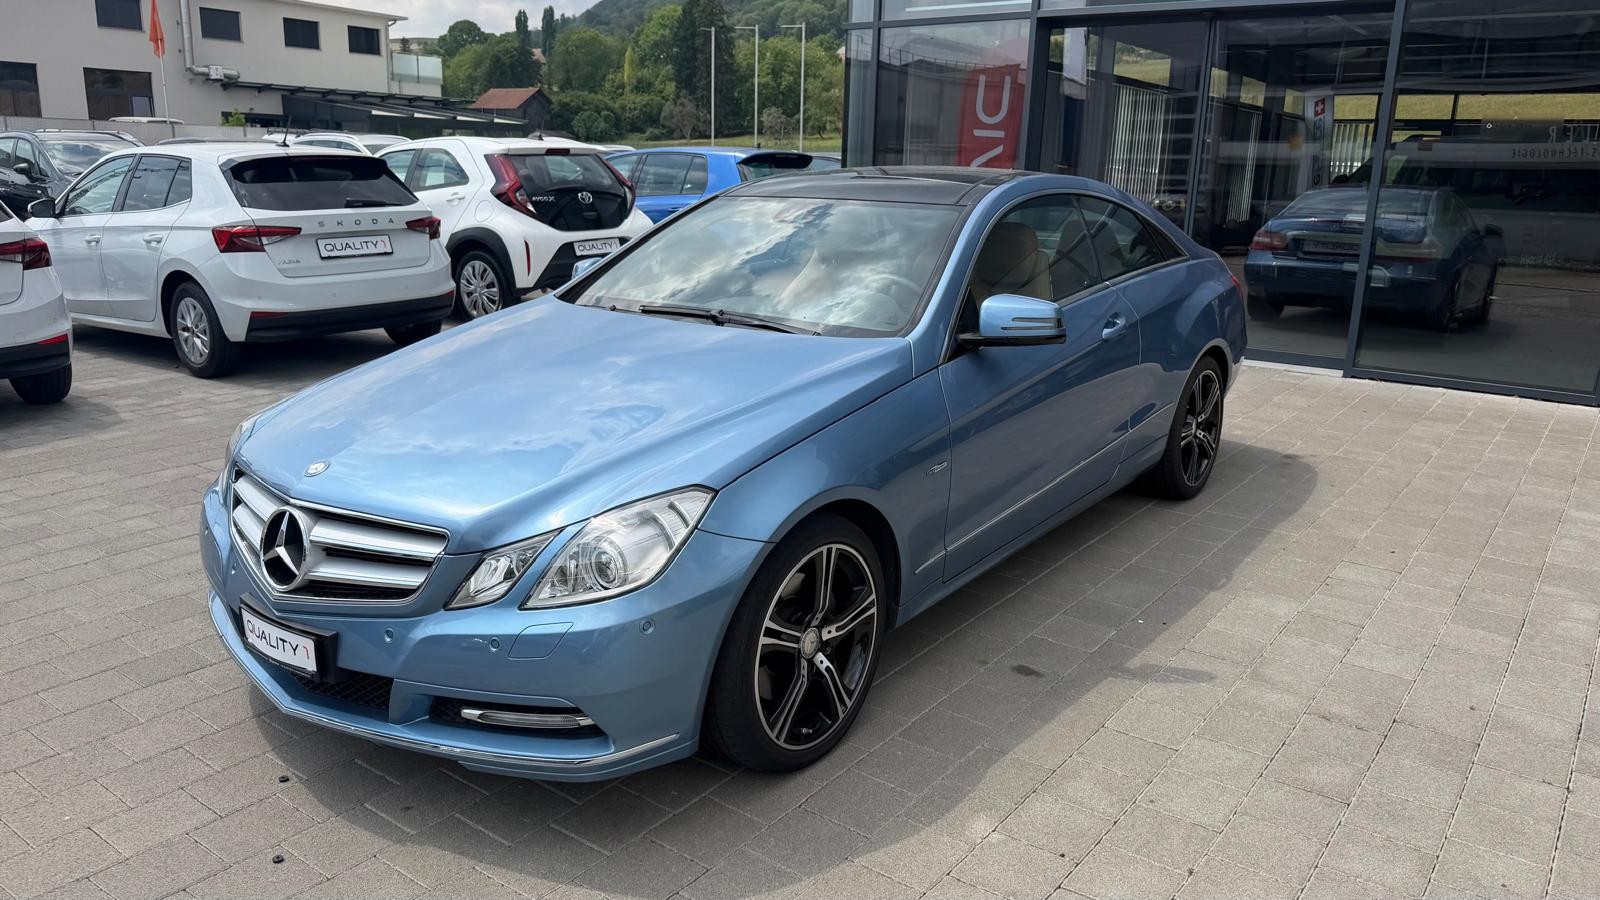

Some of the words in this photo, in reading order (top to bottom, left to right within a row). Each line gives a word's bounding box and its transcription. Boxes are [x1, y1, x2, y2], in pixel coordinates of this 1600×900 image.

[318, 217, 394, 227] SKODA
[323, 240, 378, 252] QUALITY
[577, 241, 613, 252] QUALITY
[247, 619, 299, 656] QUALITY
[303, 645, 310, 660] 1
